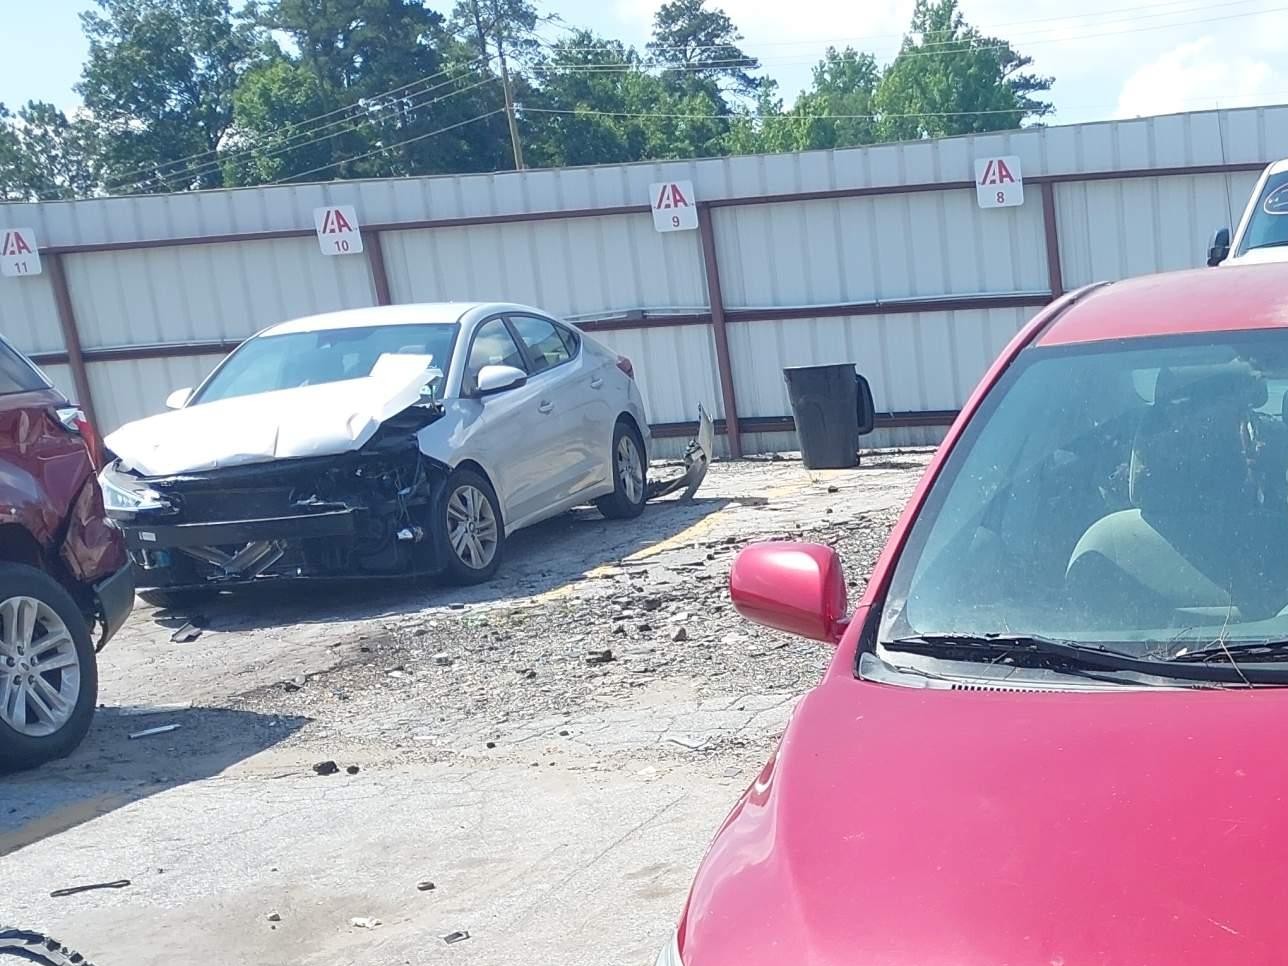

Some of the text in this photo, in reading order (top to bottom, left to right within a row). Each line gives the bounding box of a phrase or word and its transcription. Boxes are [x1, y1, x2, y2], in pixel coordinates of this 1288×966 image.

[996, 191, 1004, 203] 8
[671, 216, 680, 227] 9
[334, 240, 349, 252] 10
[14, 261, 28, 273] 11
